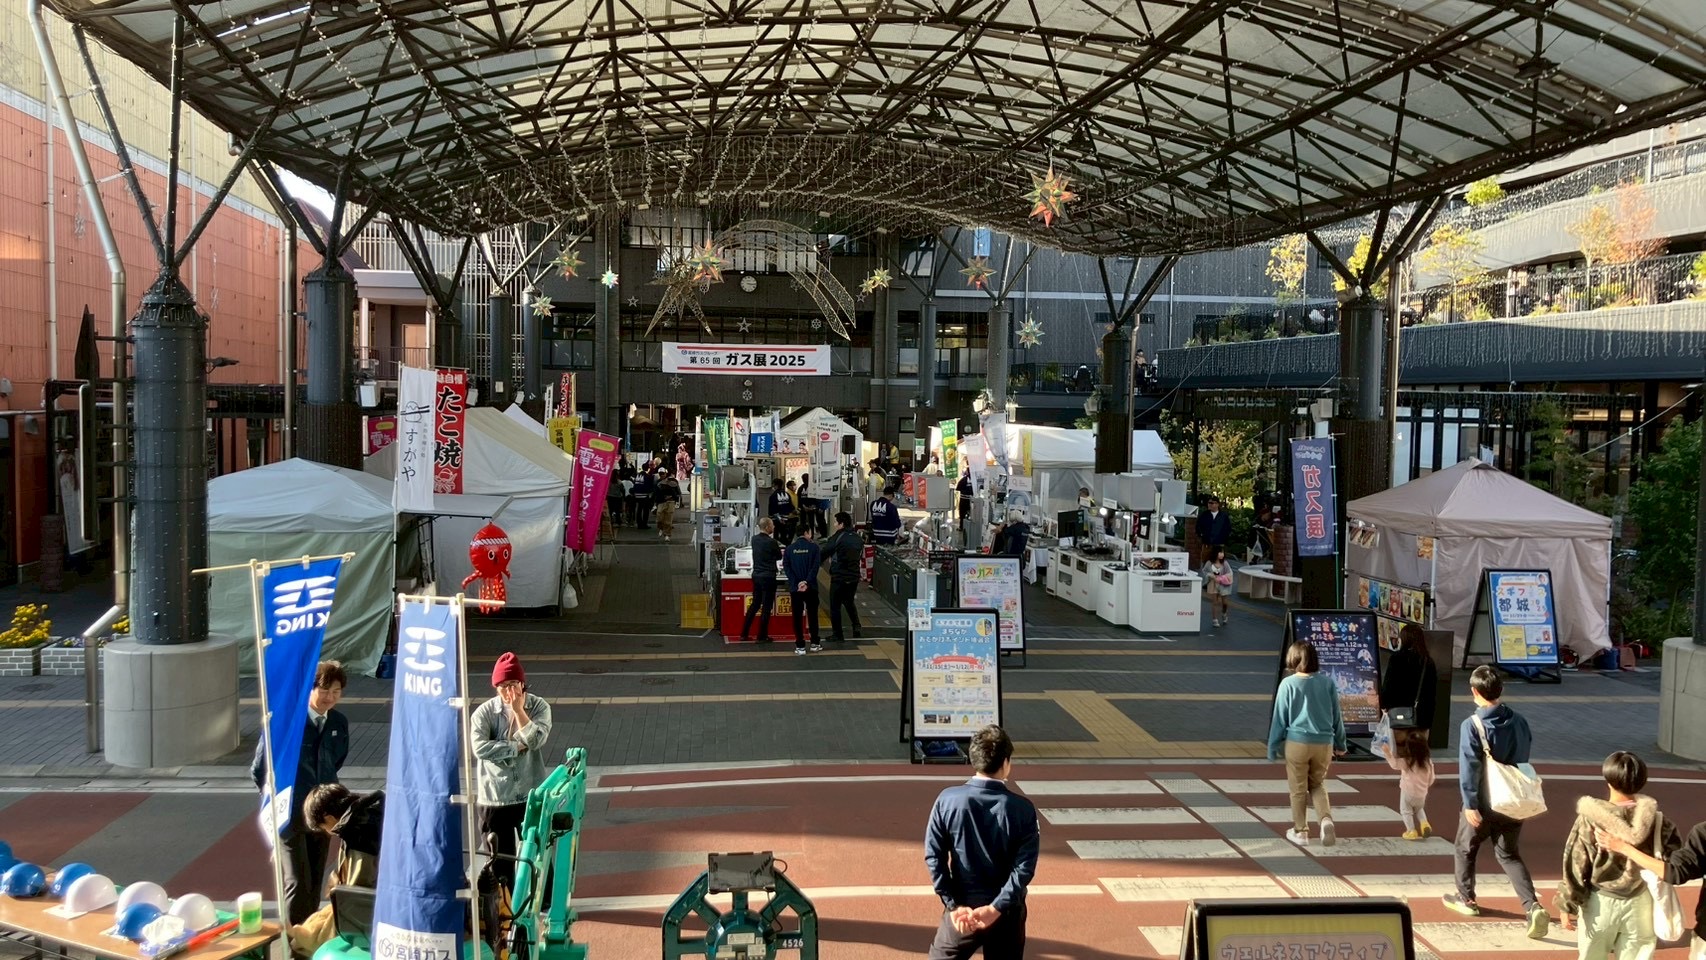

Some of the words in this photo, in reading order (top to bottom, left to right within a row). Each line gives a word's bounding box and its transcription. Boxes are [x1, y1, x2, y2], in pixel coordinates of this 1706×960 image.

[434, 385, 463, 469] たこ焼
[401, 428, 418, 482] すがや
[578, 446, 605, 470] 電気
[403, 672, 443, 696] KING
[782, 938, 804, 948] 4526
